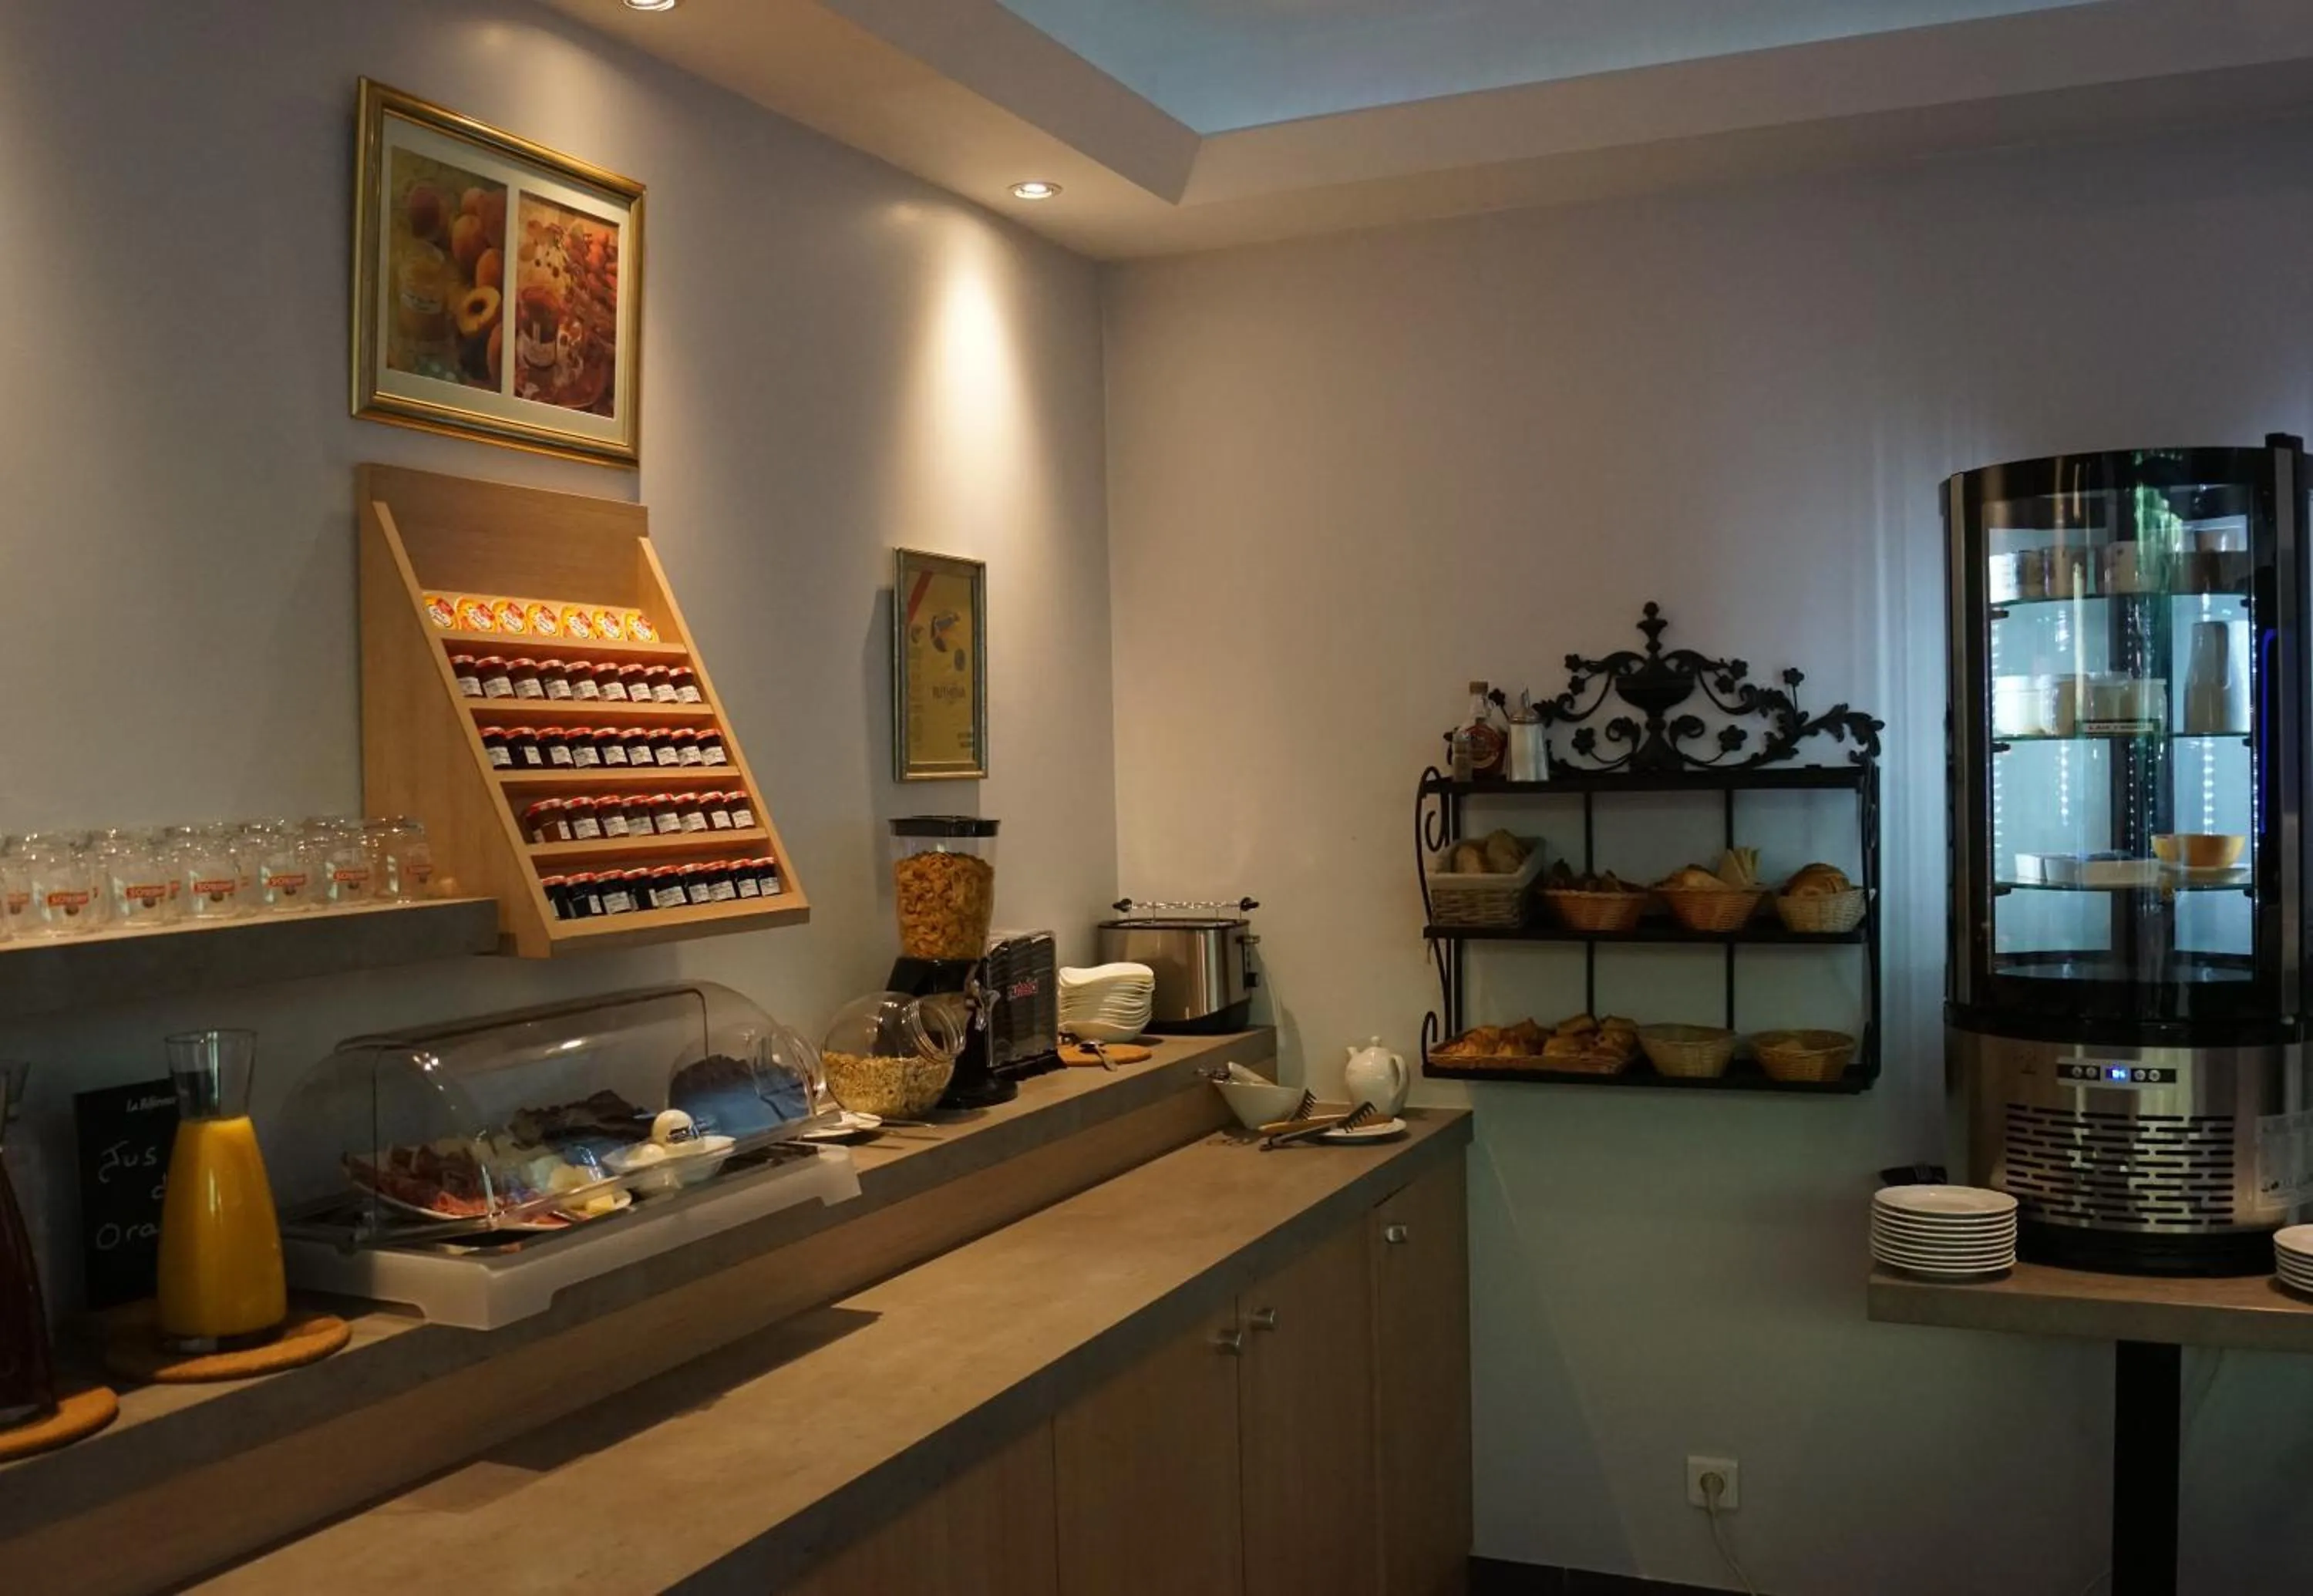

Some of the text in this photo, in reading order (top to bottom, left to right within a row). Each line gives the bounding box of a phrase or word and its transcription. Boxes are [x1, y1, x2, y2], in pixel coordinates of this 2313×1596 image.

[98, 1140, 158, 1185] Jus
[150, 1171, 167, 1200] d
[96, 1221, 161, 1251] Ora
